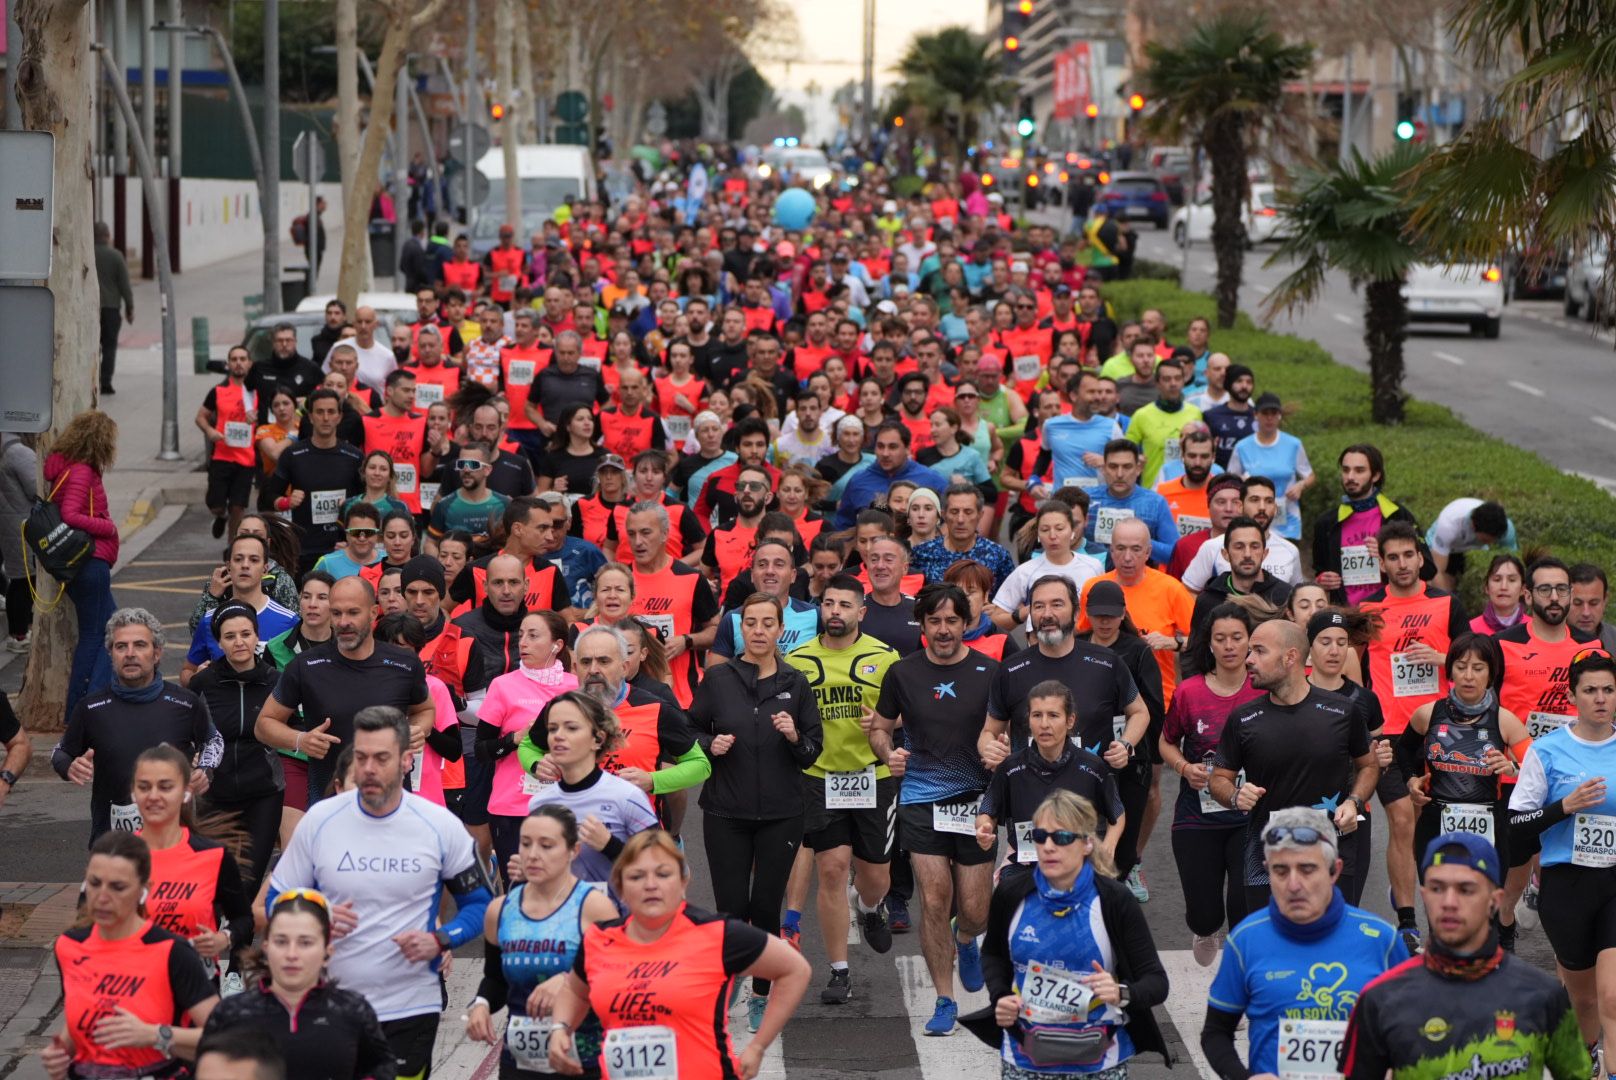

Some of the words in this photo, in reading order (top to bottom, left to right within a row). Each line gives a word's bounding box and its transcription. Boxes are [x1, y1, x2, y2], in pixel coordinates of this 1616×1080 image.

[315, 499, 339, 511] 403
[1342, 556, 1374, 570] 2674
[645, 597, 673, 611] RUN
[1401, 615, 1432, 628] RUN
[778, 629, 801, 644] UN
[1397, 663, 1433, 679] 3759
[1548, 667, 1570, 682] RU
[813, 685, 863, 705] PLAYAS
[1528, 723, 1559, 739] 35
[831, 775, 870, 791] 3220
[939, 803, 978, 817] 4024
[1446, 816, 1488, 834] 3449
[1580, 827, 1614, 848] 320
[152, 881, 198, 900] RUN
[155, 901, 178, 913] FOR
[153, 913, 184, 932] IFE
[627, 961, 679, 979] RUN
[94, 974, 146, 997] RUN
[1030, 976, 1083, 1007] 3742
[609, 992, 657, 1014] LIFE
[1028, 997, 1079, 1015] ALEXANDRA
[1304, 1008, 1328, 1021] SOY
[612, 1044, 666, 1069] 3112
[1287, 1038, 1344, 1063] 2676
